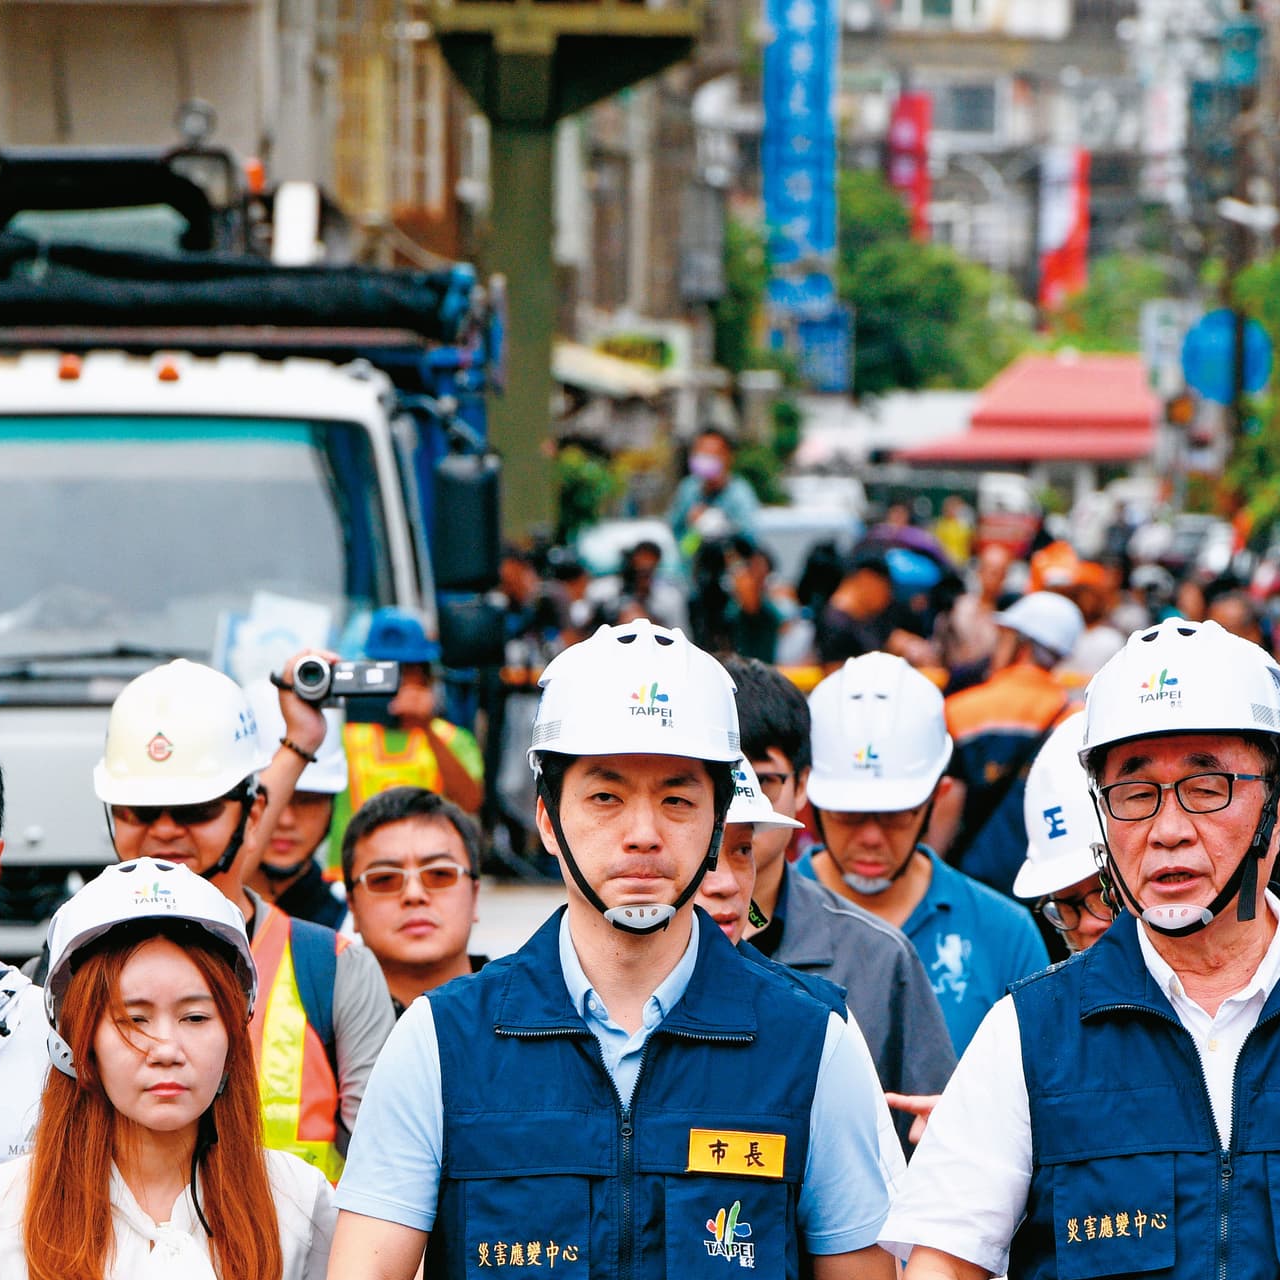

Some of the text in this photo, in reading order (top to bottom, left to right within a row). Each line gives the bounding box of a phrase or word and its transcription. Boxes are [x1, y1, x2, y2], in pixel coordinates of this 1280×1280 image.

[1138, 690, 1182, 704] TAIPEI
[628, 706, 673, 718] TAIPEI
[708, 1138, 766, 1168] 市長
[1066, 1208, 1168, 1244] 災害應變中心
[477, 1240, 579, 1269] 災害應變中心
[704, 1240, 755, 1260] TAIPEI
